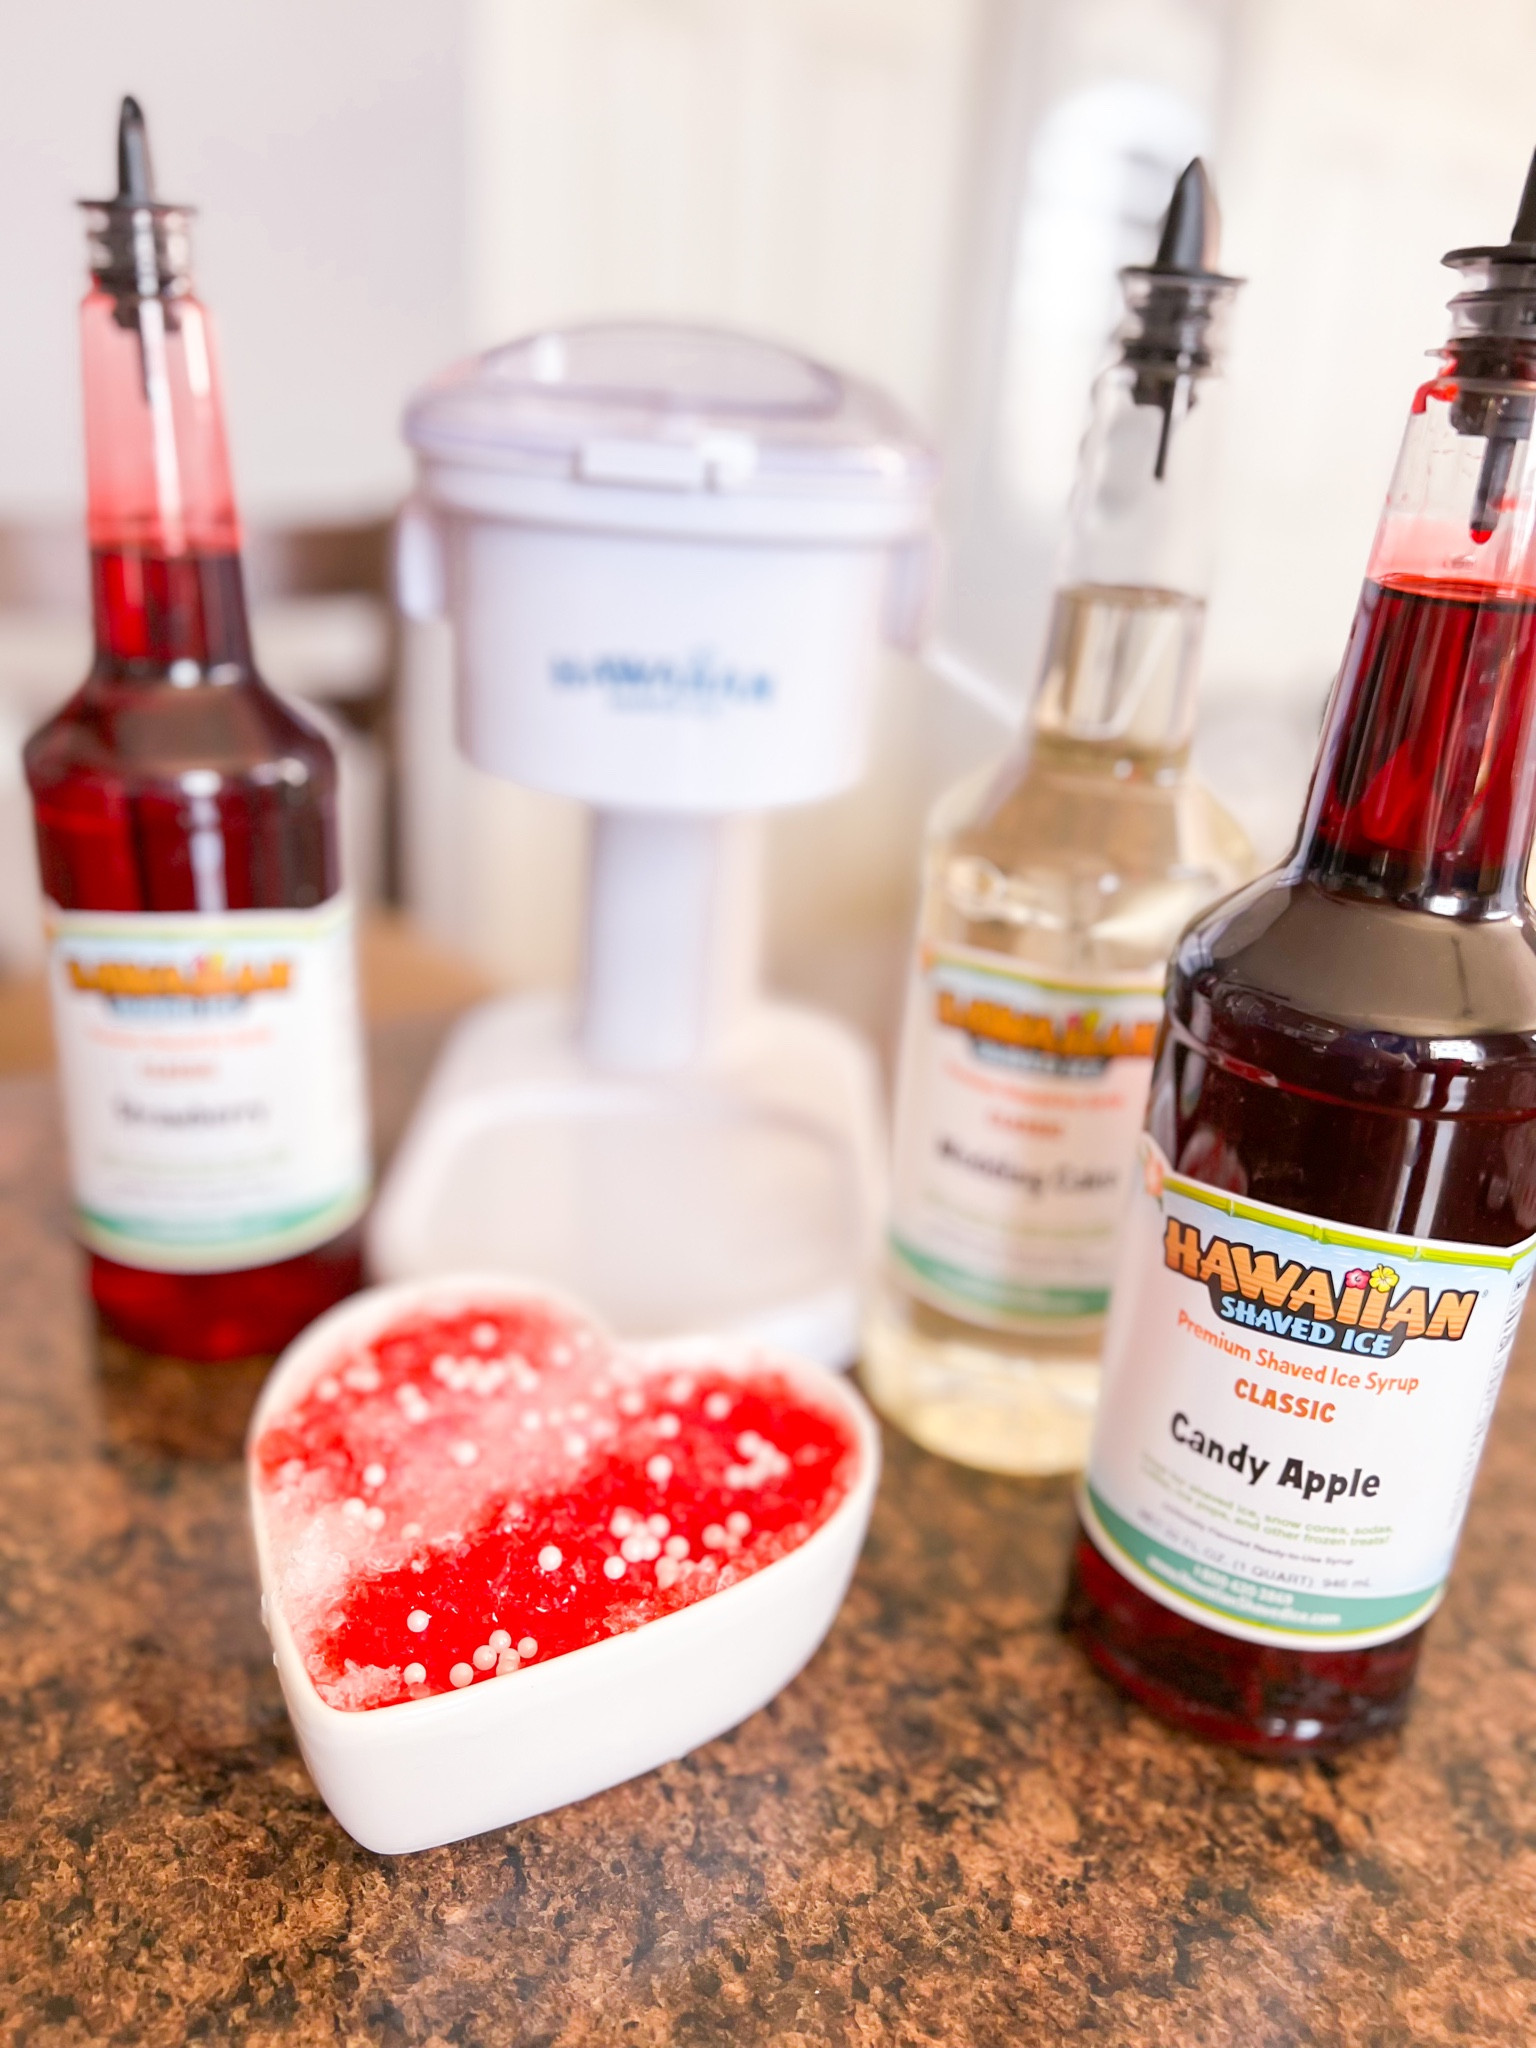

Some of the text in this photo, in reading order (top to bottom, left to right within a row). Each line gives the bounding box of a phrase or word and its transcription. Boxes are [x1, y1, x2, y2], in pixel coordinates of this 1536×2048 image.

[1164, 1216, 1479, 1341] HAWAIIAN
[1177, 1309, 1420, 1396] Premium Shaved Ice Syrup
[1220, 1295, 1394, 1357] SHAVED ICE
[1233, 1378, 1337, 1425] CLASSIC
[1170, 1412, 1271, 1486] Candy
[1277, 1457, 1381, 1503] Apple
[1262, 1524, 1301, 1542] other
[1303, 1532, 1347, 1547] frozen
[1263, 1513, 1303, 1530] snow
